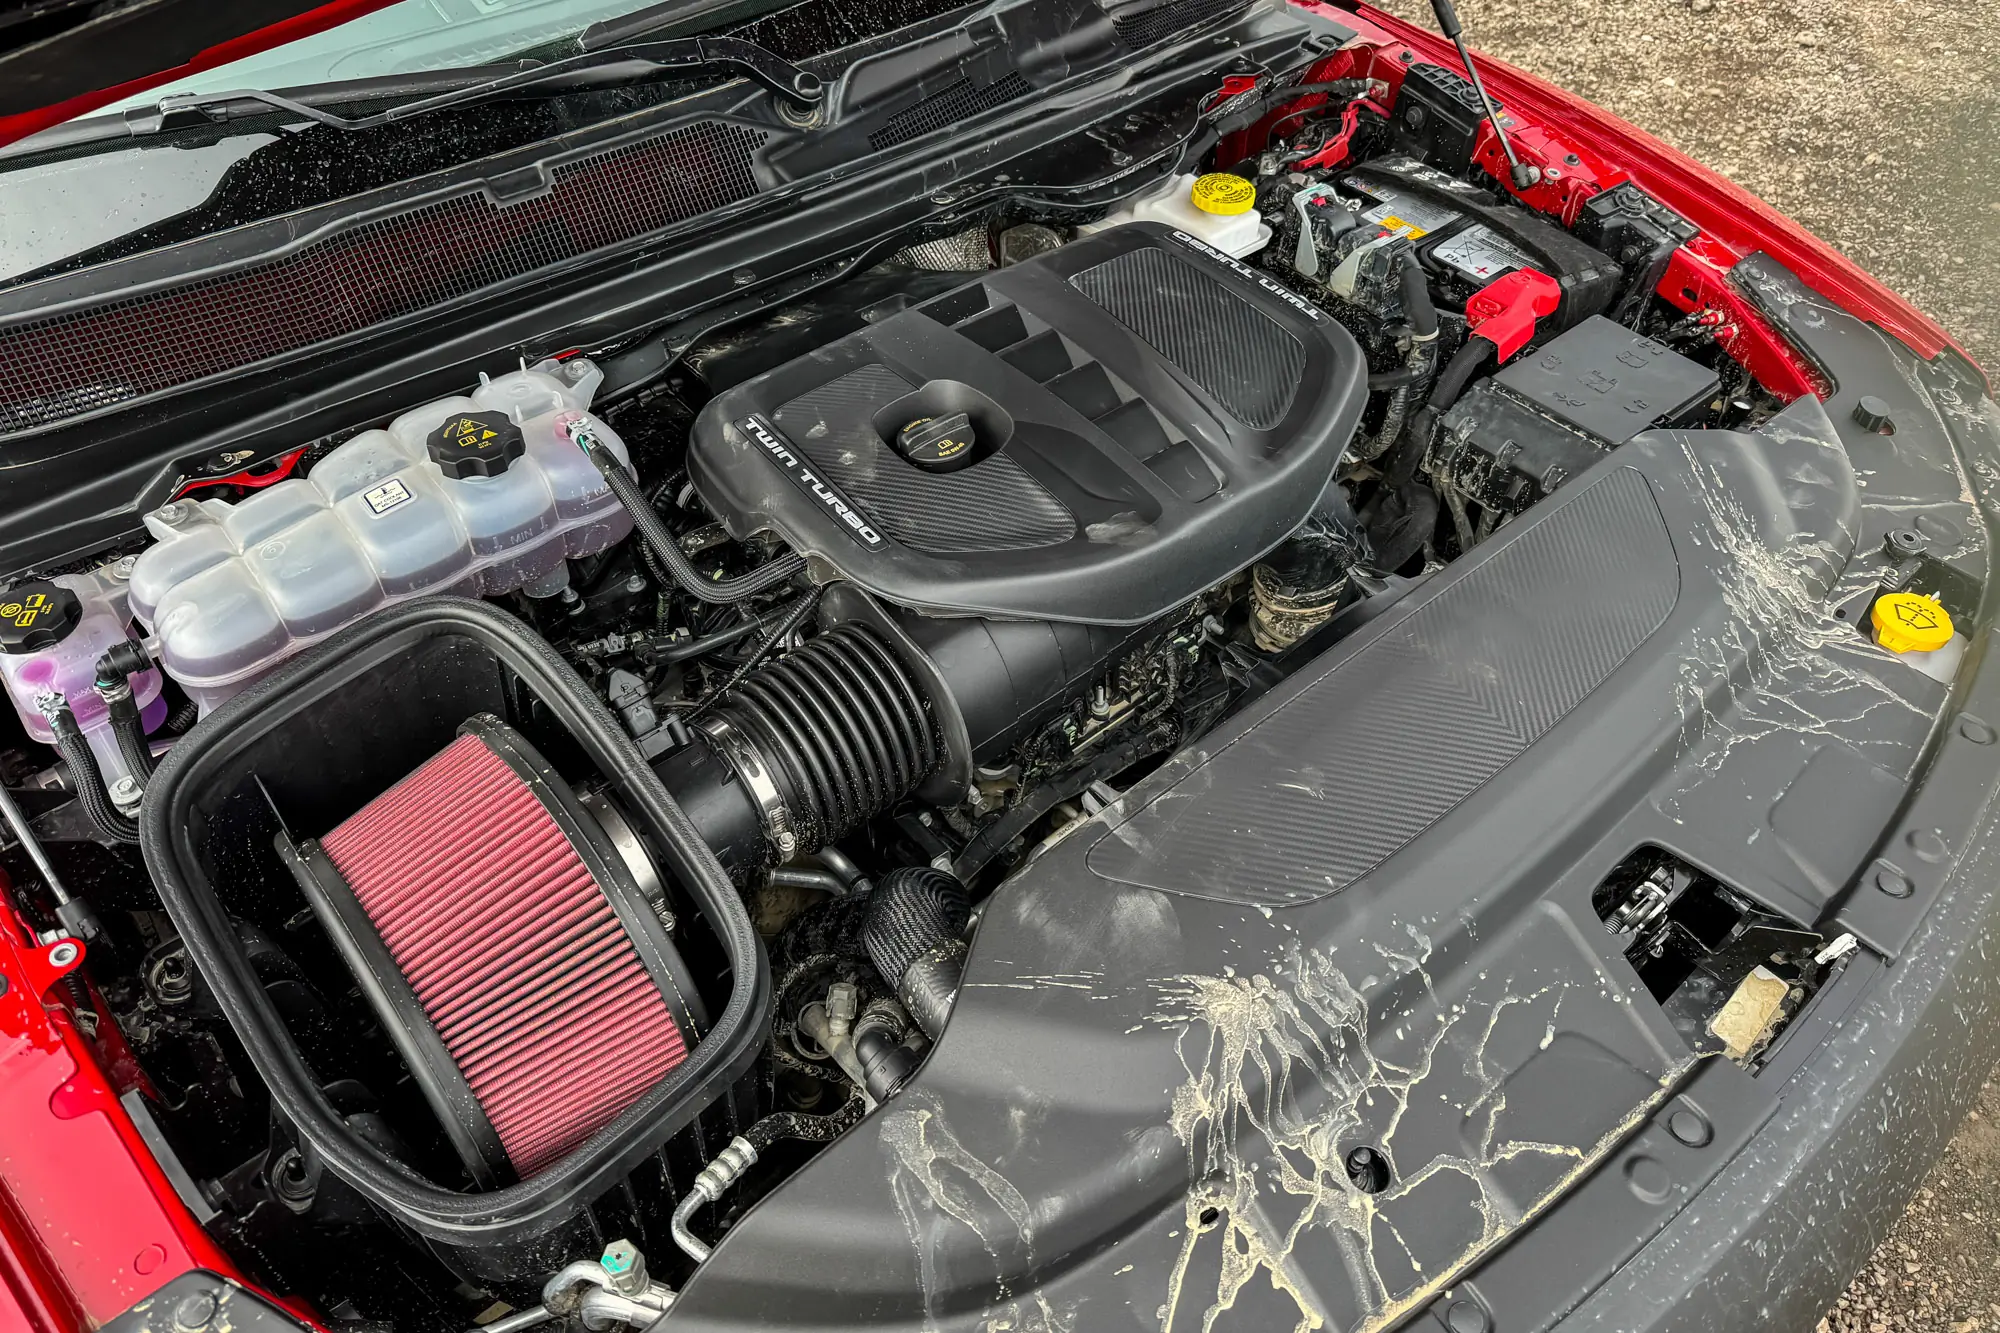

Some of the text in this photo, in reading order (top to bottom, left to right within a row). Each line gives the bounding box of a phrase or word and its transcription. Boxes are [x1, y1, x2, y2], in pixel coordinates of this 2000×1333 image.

[1172, 230, 1319, 321] TWIN TURBO
[745, 417, 881, 544] TWIN TURBO
[510, 528, 534, 545] MIN
[72, 686, 92, 699] MAX
